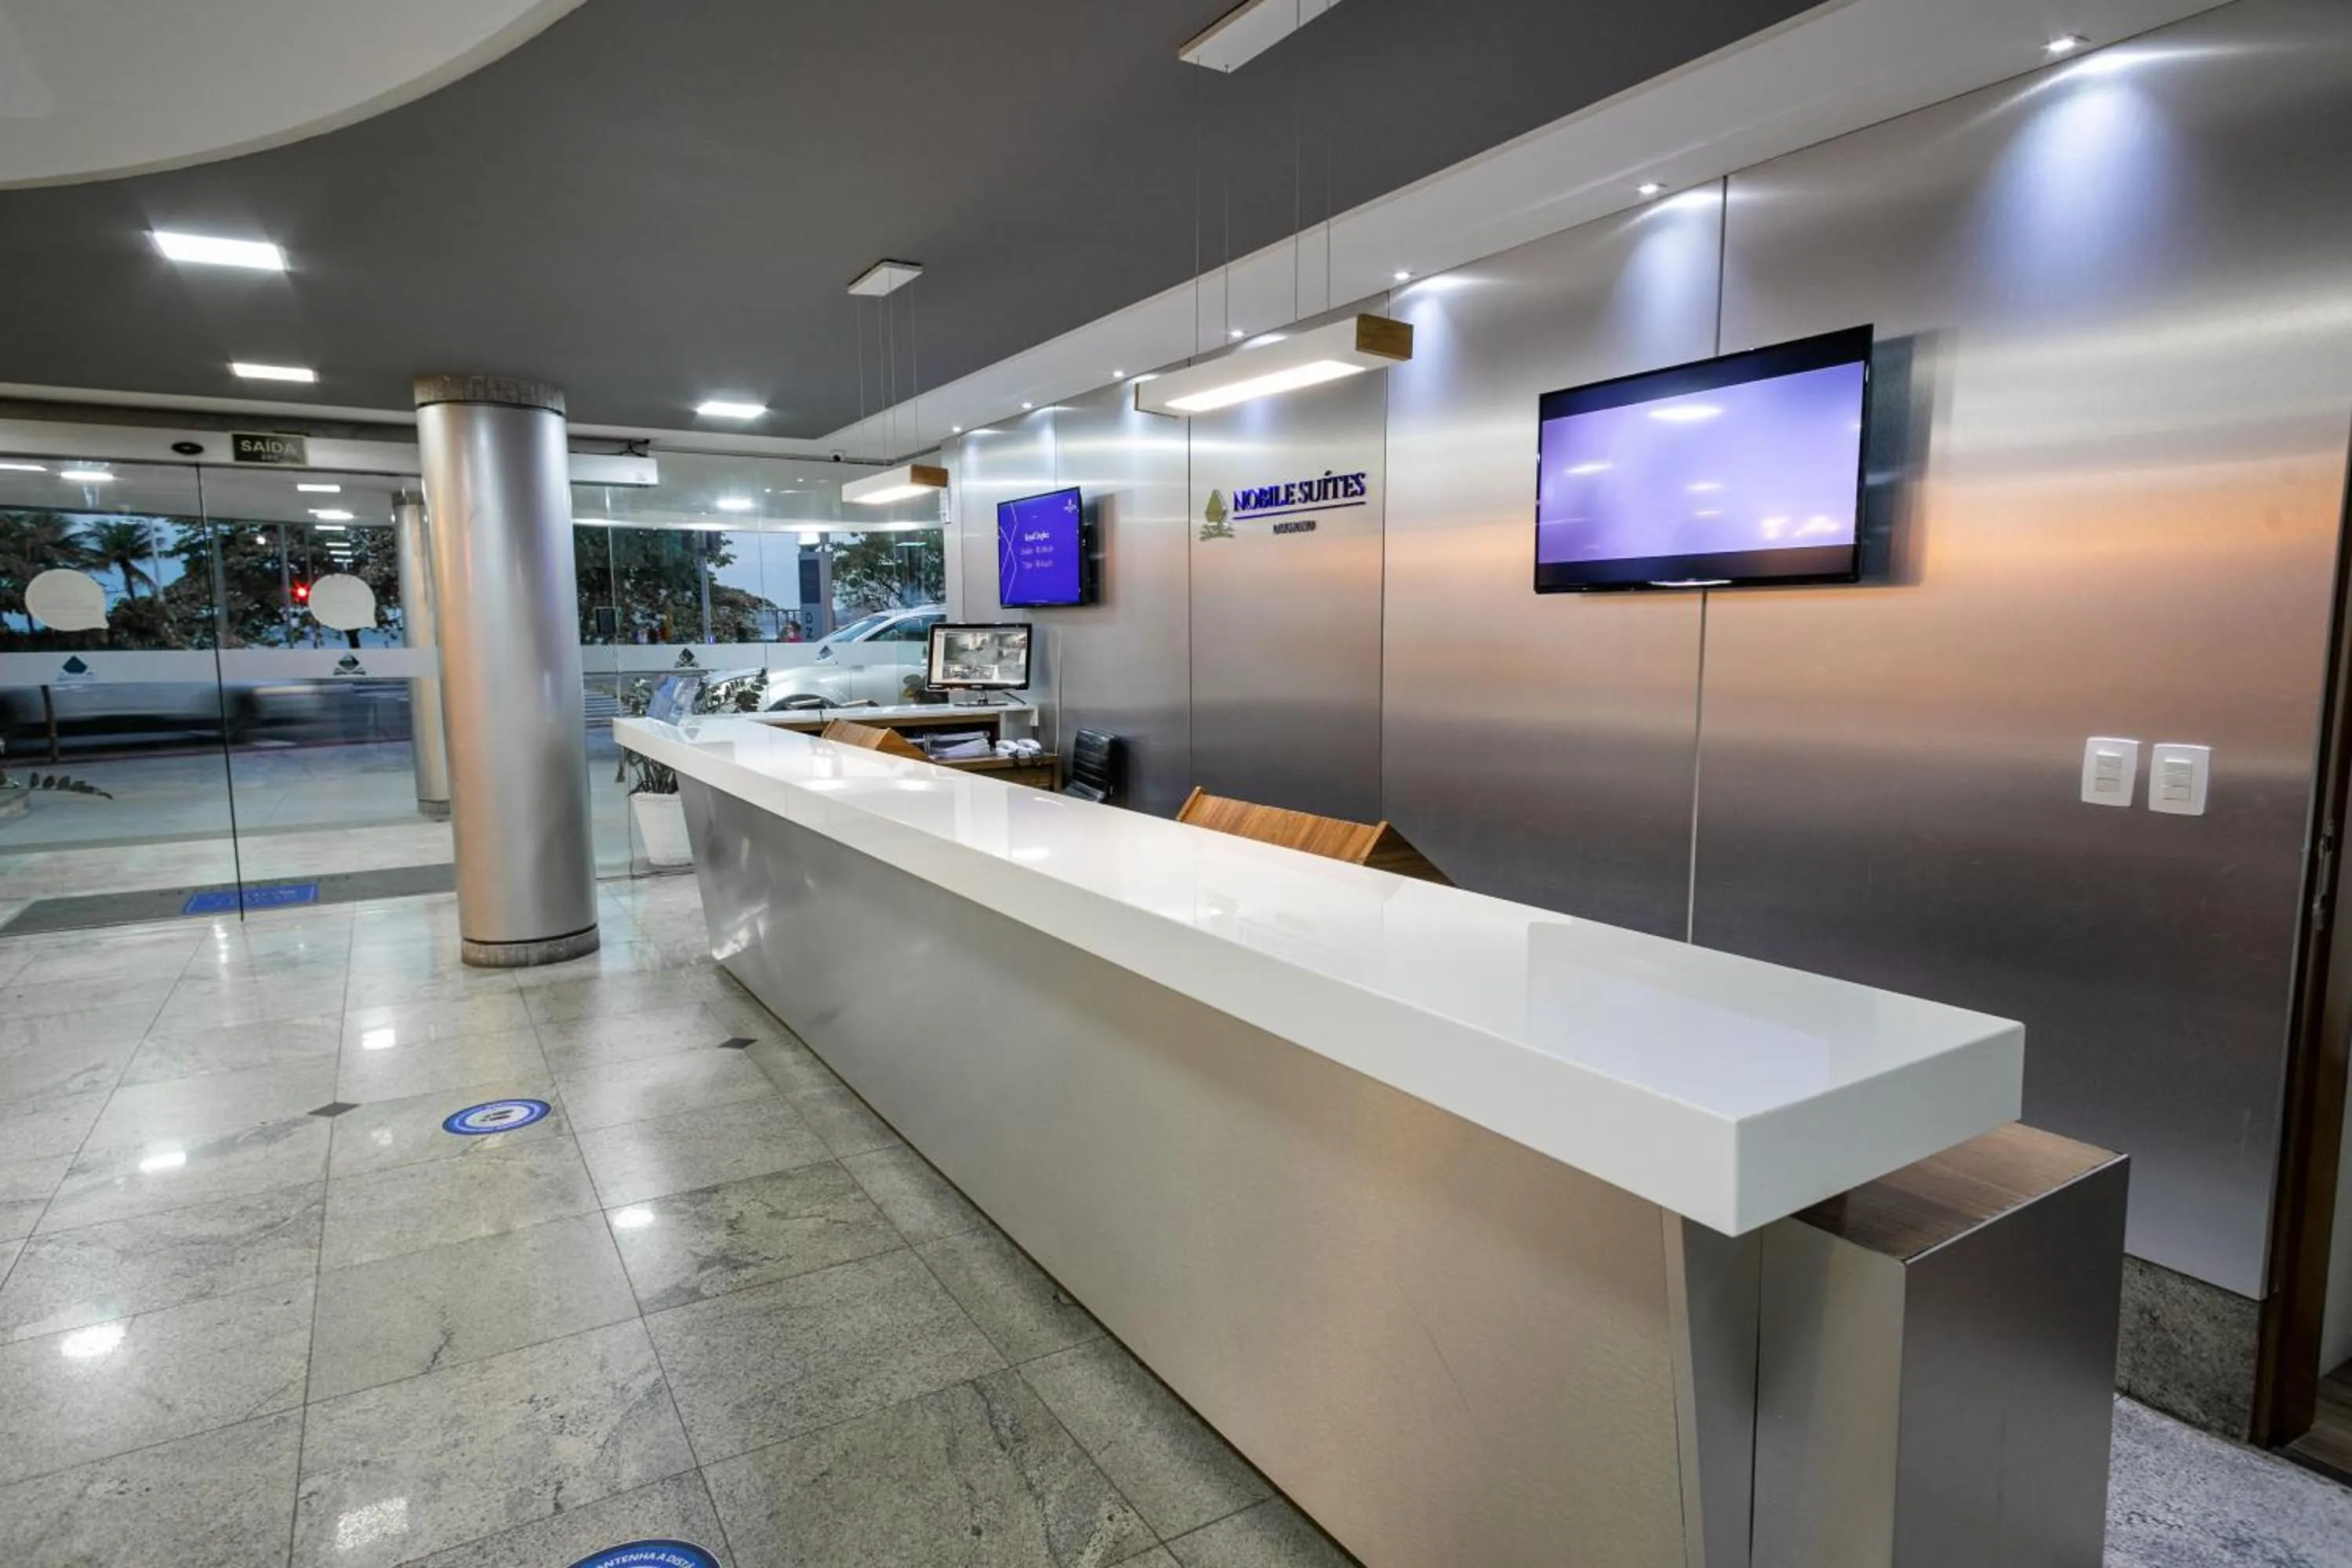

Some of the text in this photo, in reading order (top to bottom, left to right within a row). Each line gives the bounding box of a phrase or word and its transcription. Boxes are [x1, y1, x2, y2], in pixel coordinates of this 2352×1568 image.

[241, 439, 296, 455] SAÍDA
[1233, 470, 1367, 512] NOBILE SUÍTES
